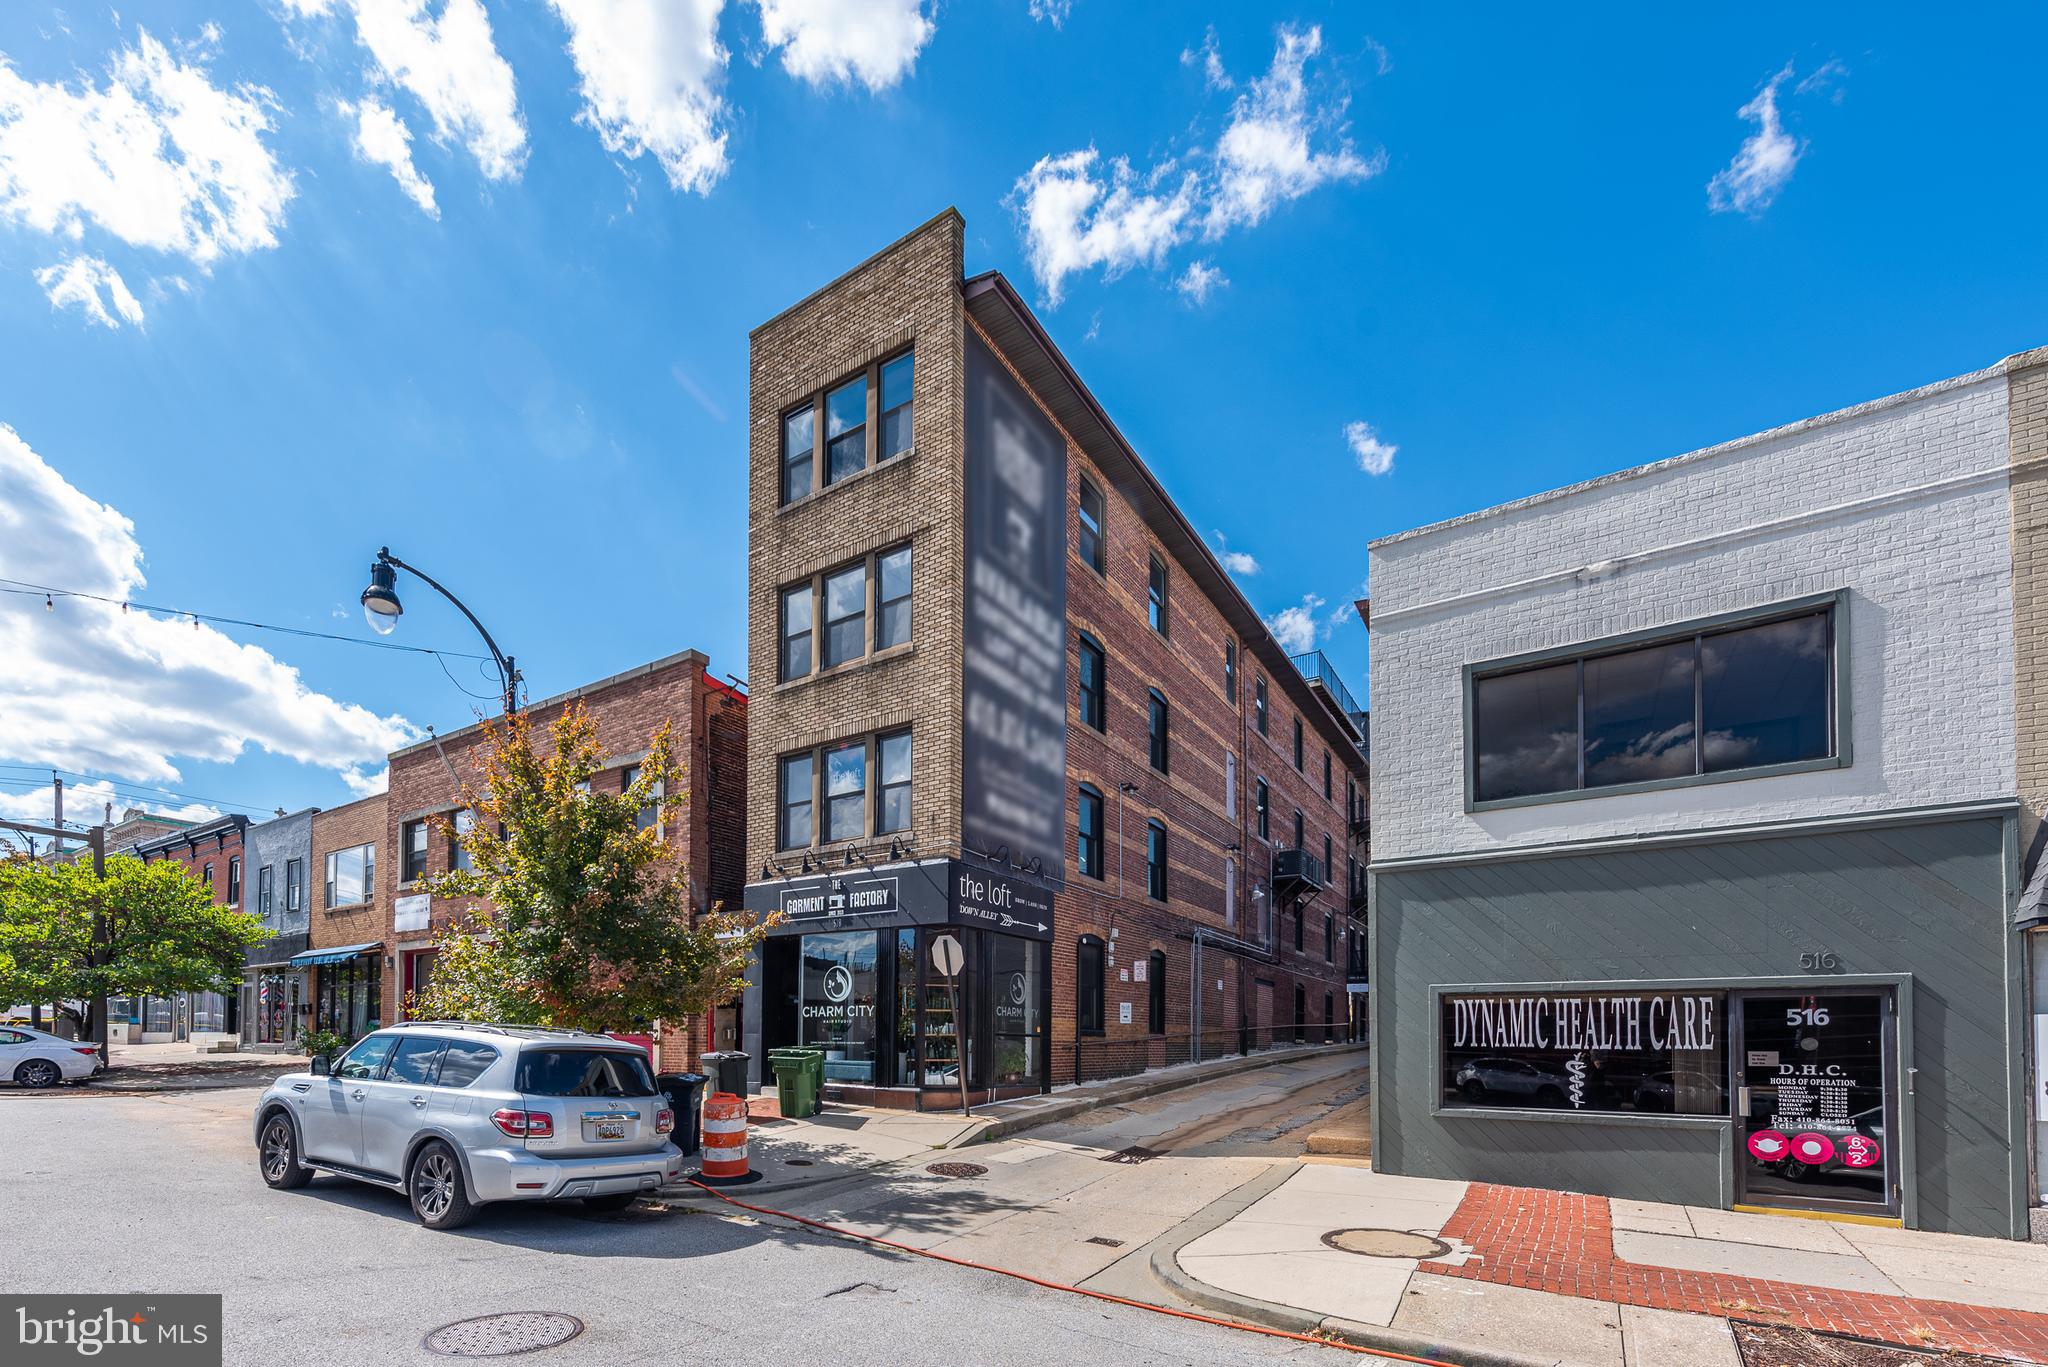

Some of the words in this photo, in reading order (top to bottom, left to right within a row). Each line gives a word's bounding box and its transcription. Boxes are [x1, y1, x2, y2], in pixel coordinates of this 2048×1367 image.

[960, 873, 984, 901] the
[988, 880, 1012, 909] loft
[786, 896, 825, 914] GARMENT
[849, 889, 889, 908] FACTORY
[979, 910, 999, 921] ALLEY
[1799, 952, 1836, 969] 516
[802, 1005, 844, 1017] CHARM
[847, 1005, 875, 1017] CITY
[996, 1006, 1022, 1017] CHARM
[1786, 1008, 1830, 1026] 516
[1453, 997, 1548, 1049] DYNAMIC
[1554, 997, 1642, 1050] HEALTH
[1649, 996, 1715, 1050] CARE
[1779, 1064, 1847, 1076] D.H.C.
[1770, 1077, 1796, 1085] HOURS
[1798, 1078, 1809, 1086] OF
[1811, 1079, 1856, 1087] OPERATION
[1771, 1115, 1793, 1123] Fax:
[1772, 1122, 1793, 1130] Tel:
[1851, 1137, 1861, 1147] 6
[1852, 1154, 1862, 1165] 2
